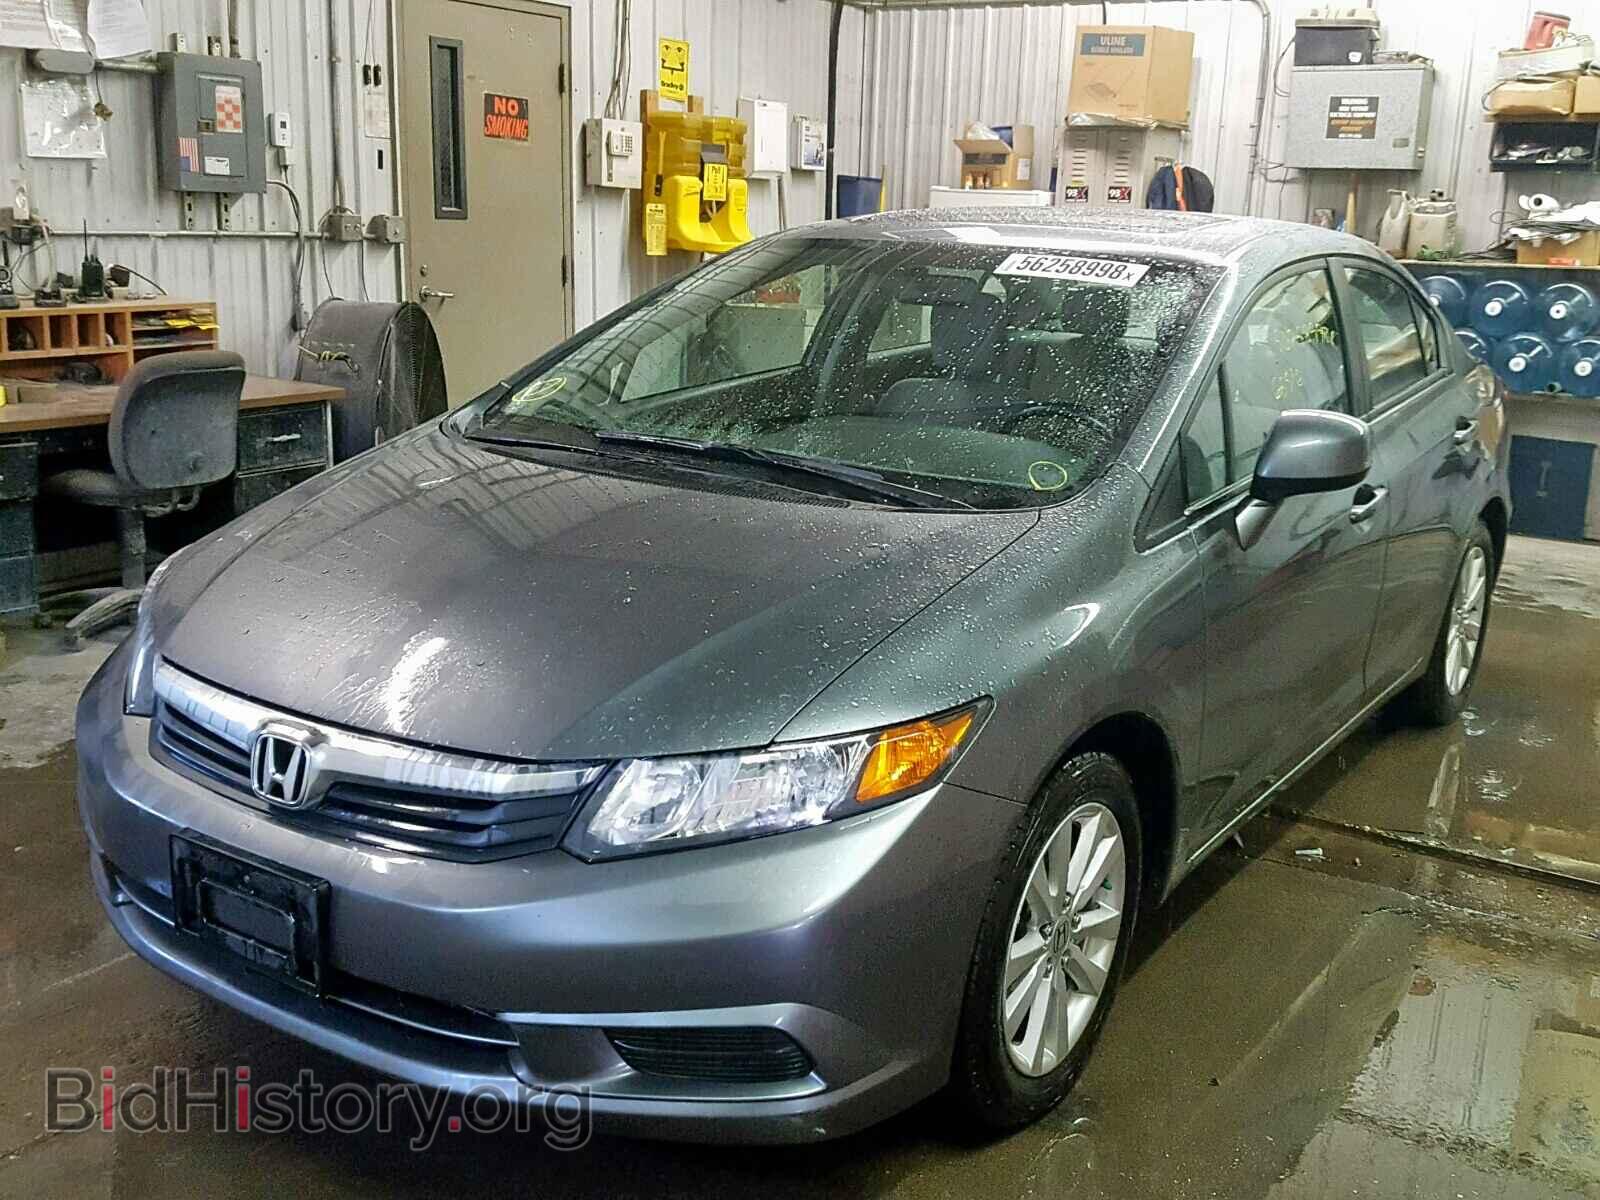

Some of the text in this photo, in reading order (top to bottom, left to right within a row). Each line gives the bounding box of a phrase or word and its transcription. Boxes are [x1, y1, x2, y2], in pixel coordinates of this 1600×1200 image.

[1100, 36, 1127, 46] ULINE
[494, 95, 518, 116] NO
[485, 114, 528, 138] SMOKING
